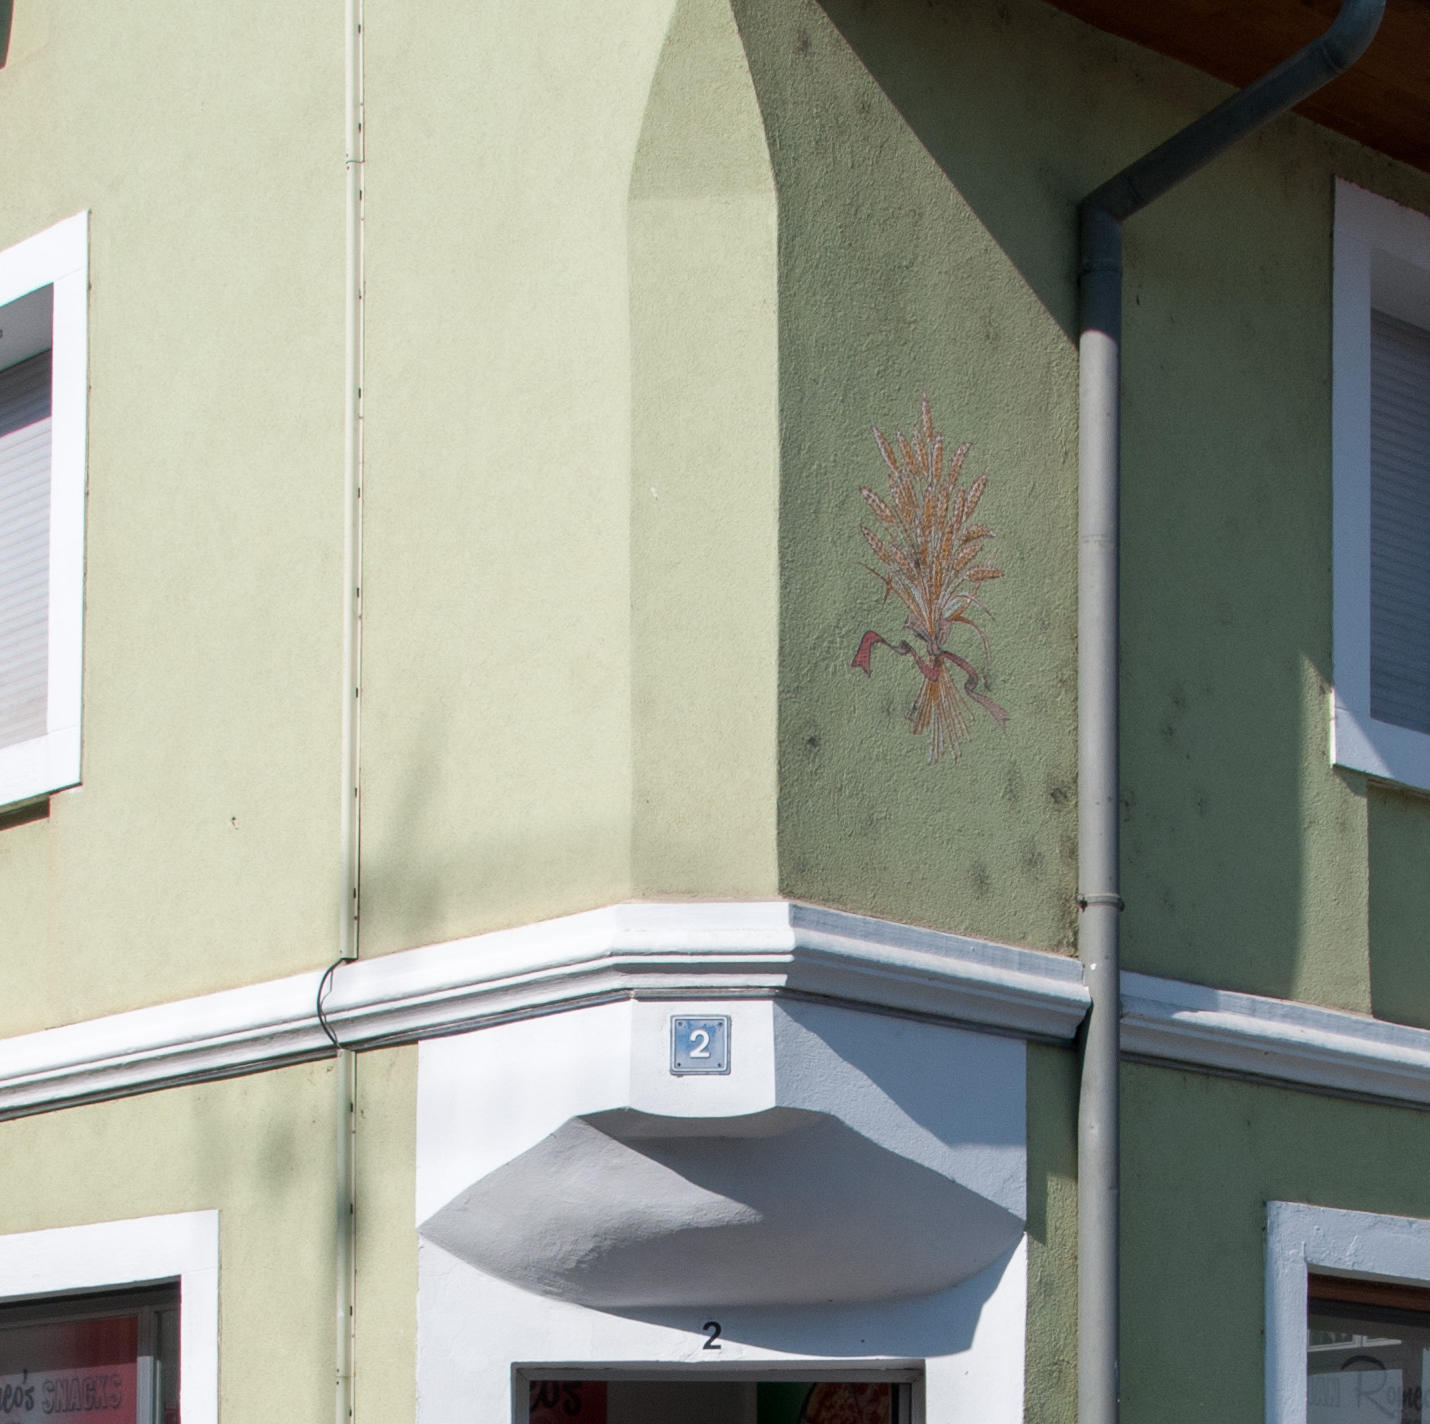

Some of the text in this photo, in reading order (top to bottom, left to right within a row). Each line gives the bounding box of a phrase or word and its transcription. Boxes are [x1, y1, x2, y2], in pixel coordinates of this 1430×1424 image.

[688, 1029, 711, 1059] 2
[702, 1321, 722, 1350] 2
[42, 1373, 123, 1414] SNACKS
